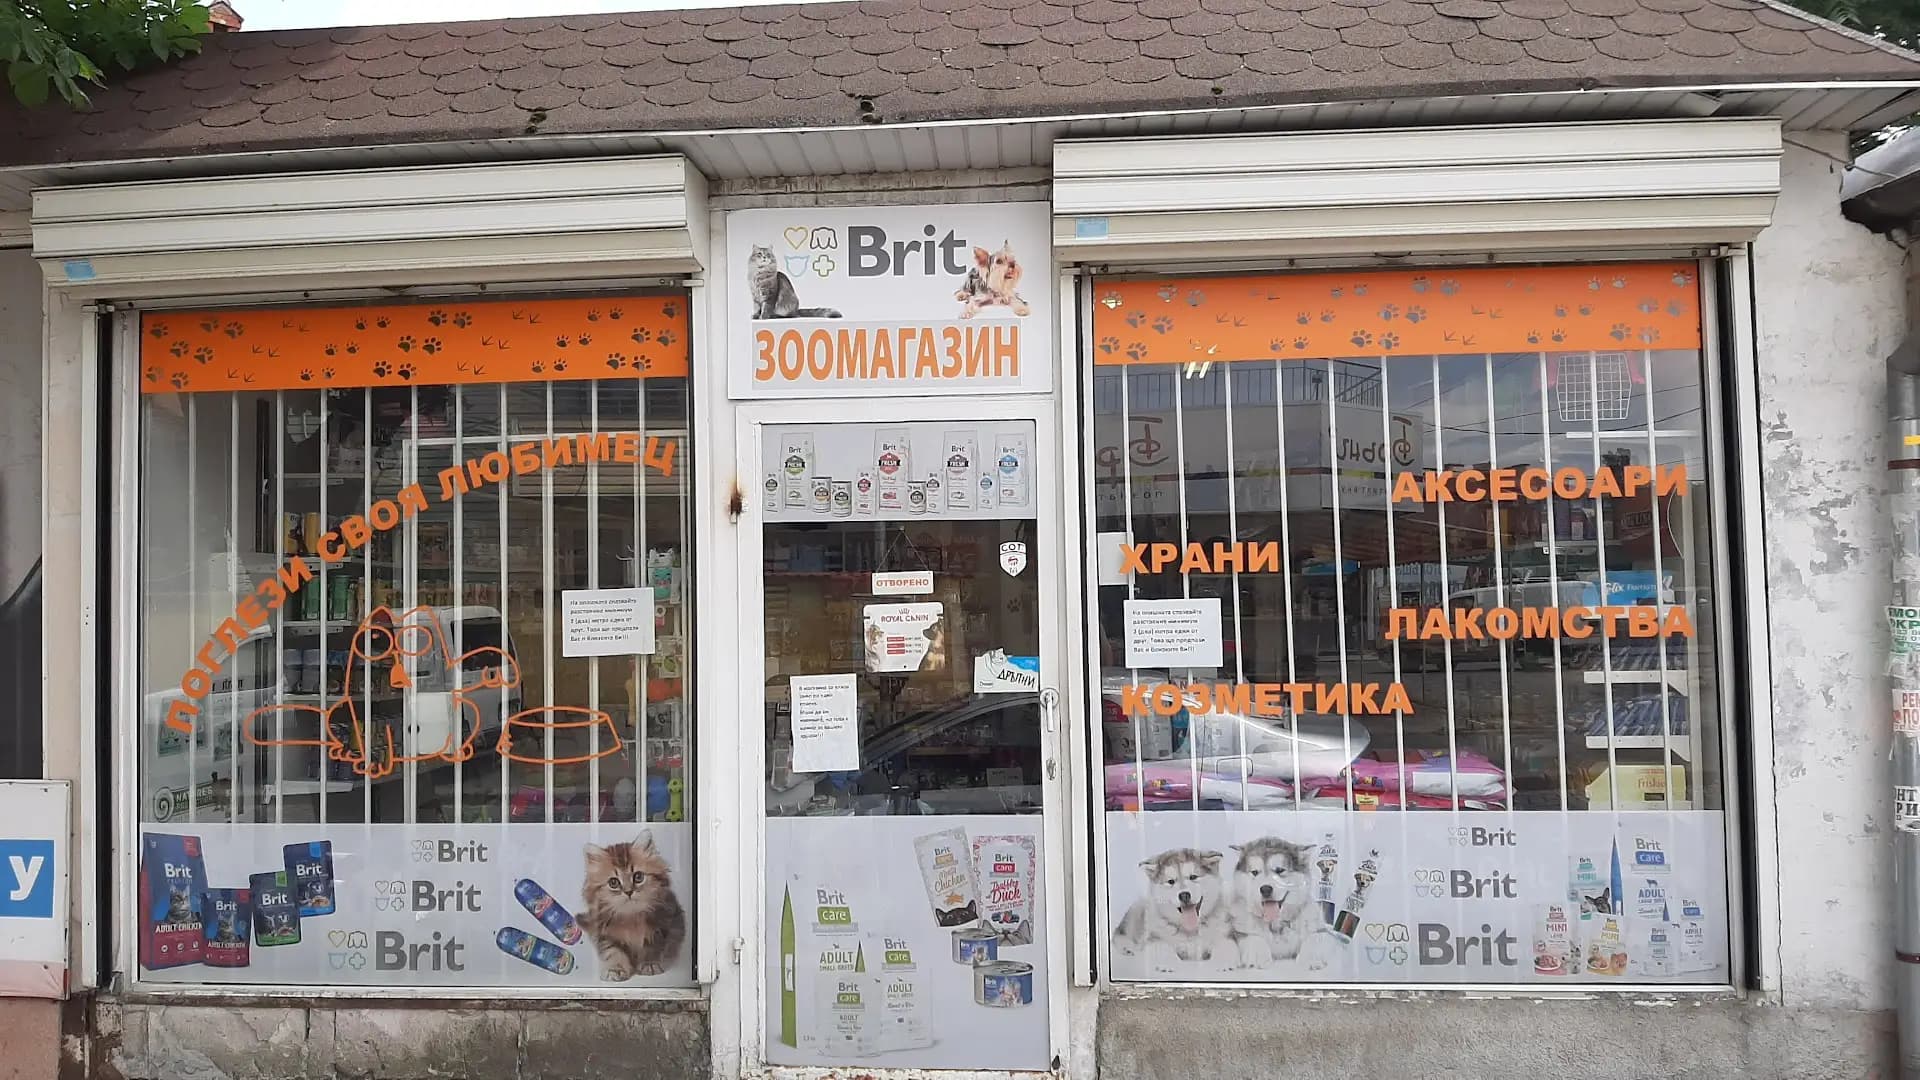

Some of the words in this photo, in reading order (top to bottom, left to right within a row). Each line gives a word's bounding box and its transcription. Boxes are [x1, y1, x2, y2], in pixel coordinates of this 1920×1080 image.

[848, 224, 967, 277] Brit
[755, 325, 1019, 382] ЗООМАГАЗИН
[882, 443, 897, 451] Brit
[951, 445, 965, 453] Brit
[1392, 464, 1687, 503] АКСЕСОАРИ
[1119, 541, 1280, 574] ХРАНИ
[164, 555, 314, 734] ПОГЛЕЗИ
[316, 482, 429, 563] СВОЯ
[437, 431, 677, 502] ЛЮБИМЕЦ
[876, 579, 930, 588] ОТВОРЕНО
[881, 615, 904, 623] ROYAL
[906, 614, 929, 622] CANIN
[1386, 606, 1694, 640] ЛАКОМСТВА
[1122, 683, 1414, 716] КОЗМЕТИКА
[1472, 827, 1517, 847] Brit
[438, 839, 488, 862] Brit
[1636, 838, 1662, 851] Brit
[935, 847, 950, 856] Brit
[995, 853, 1013, 862] Brit
[1639, 853, 1662, 863] care
[164, 863, 192, 879] Brit
[296, 863, 322, 877] Brit
[934, 873, 966, 893] Chicken
[1450, 870, 1517, 898] Brit
[262, 892, 287, 905] Brit
[411, 880, 482, 912] Brit
[817, 889, 847, 905] Brit
[992, 886, 1022, 904] Duck
[215, 900, 238, 912] Brit
[822, 910, 847, 921] care
[155, 923, 177, 934] ADULT
[1546, 923, 1568, 932] MINI
[885, 938, 906, 949] Brit
[1418, 923, 1518, 965] Brit
[375, 930, 465, 971] Brit
[888, 952, 907, 962] care
[820, 951, 853, 964] ADULT
[838, 982, 859, 992] Brit
[887, 983, 913, 993] ADULT
[839, 994, 857, 1002] care
